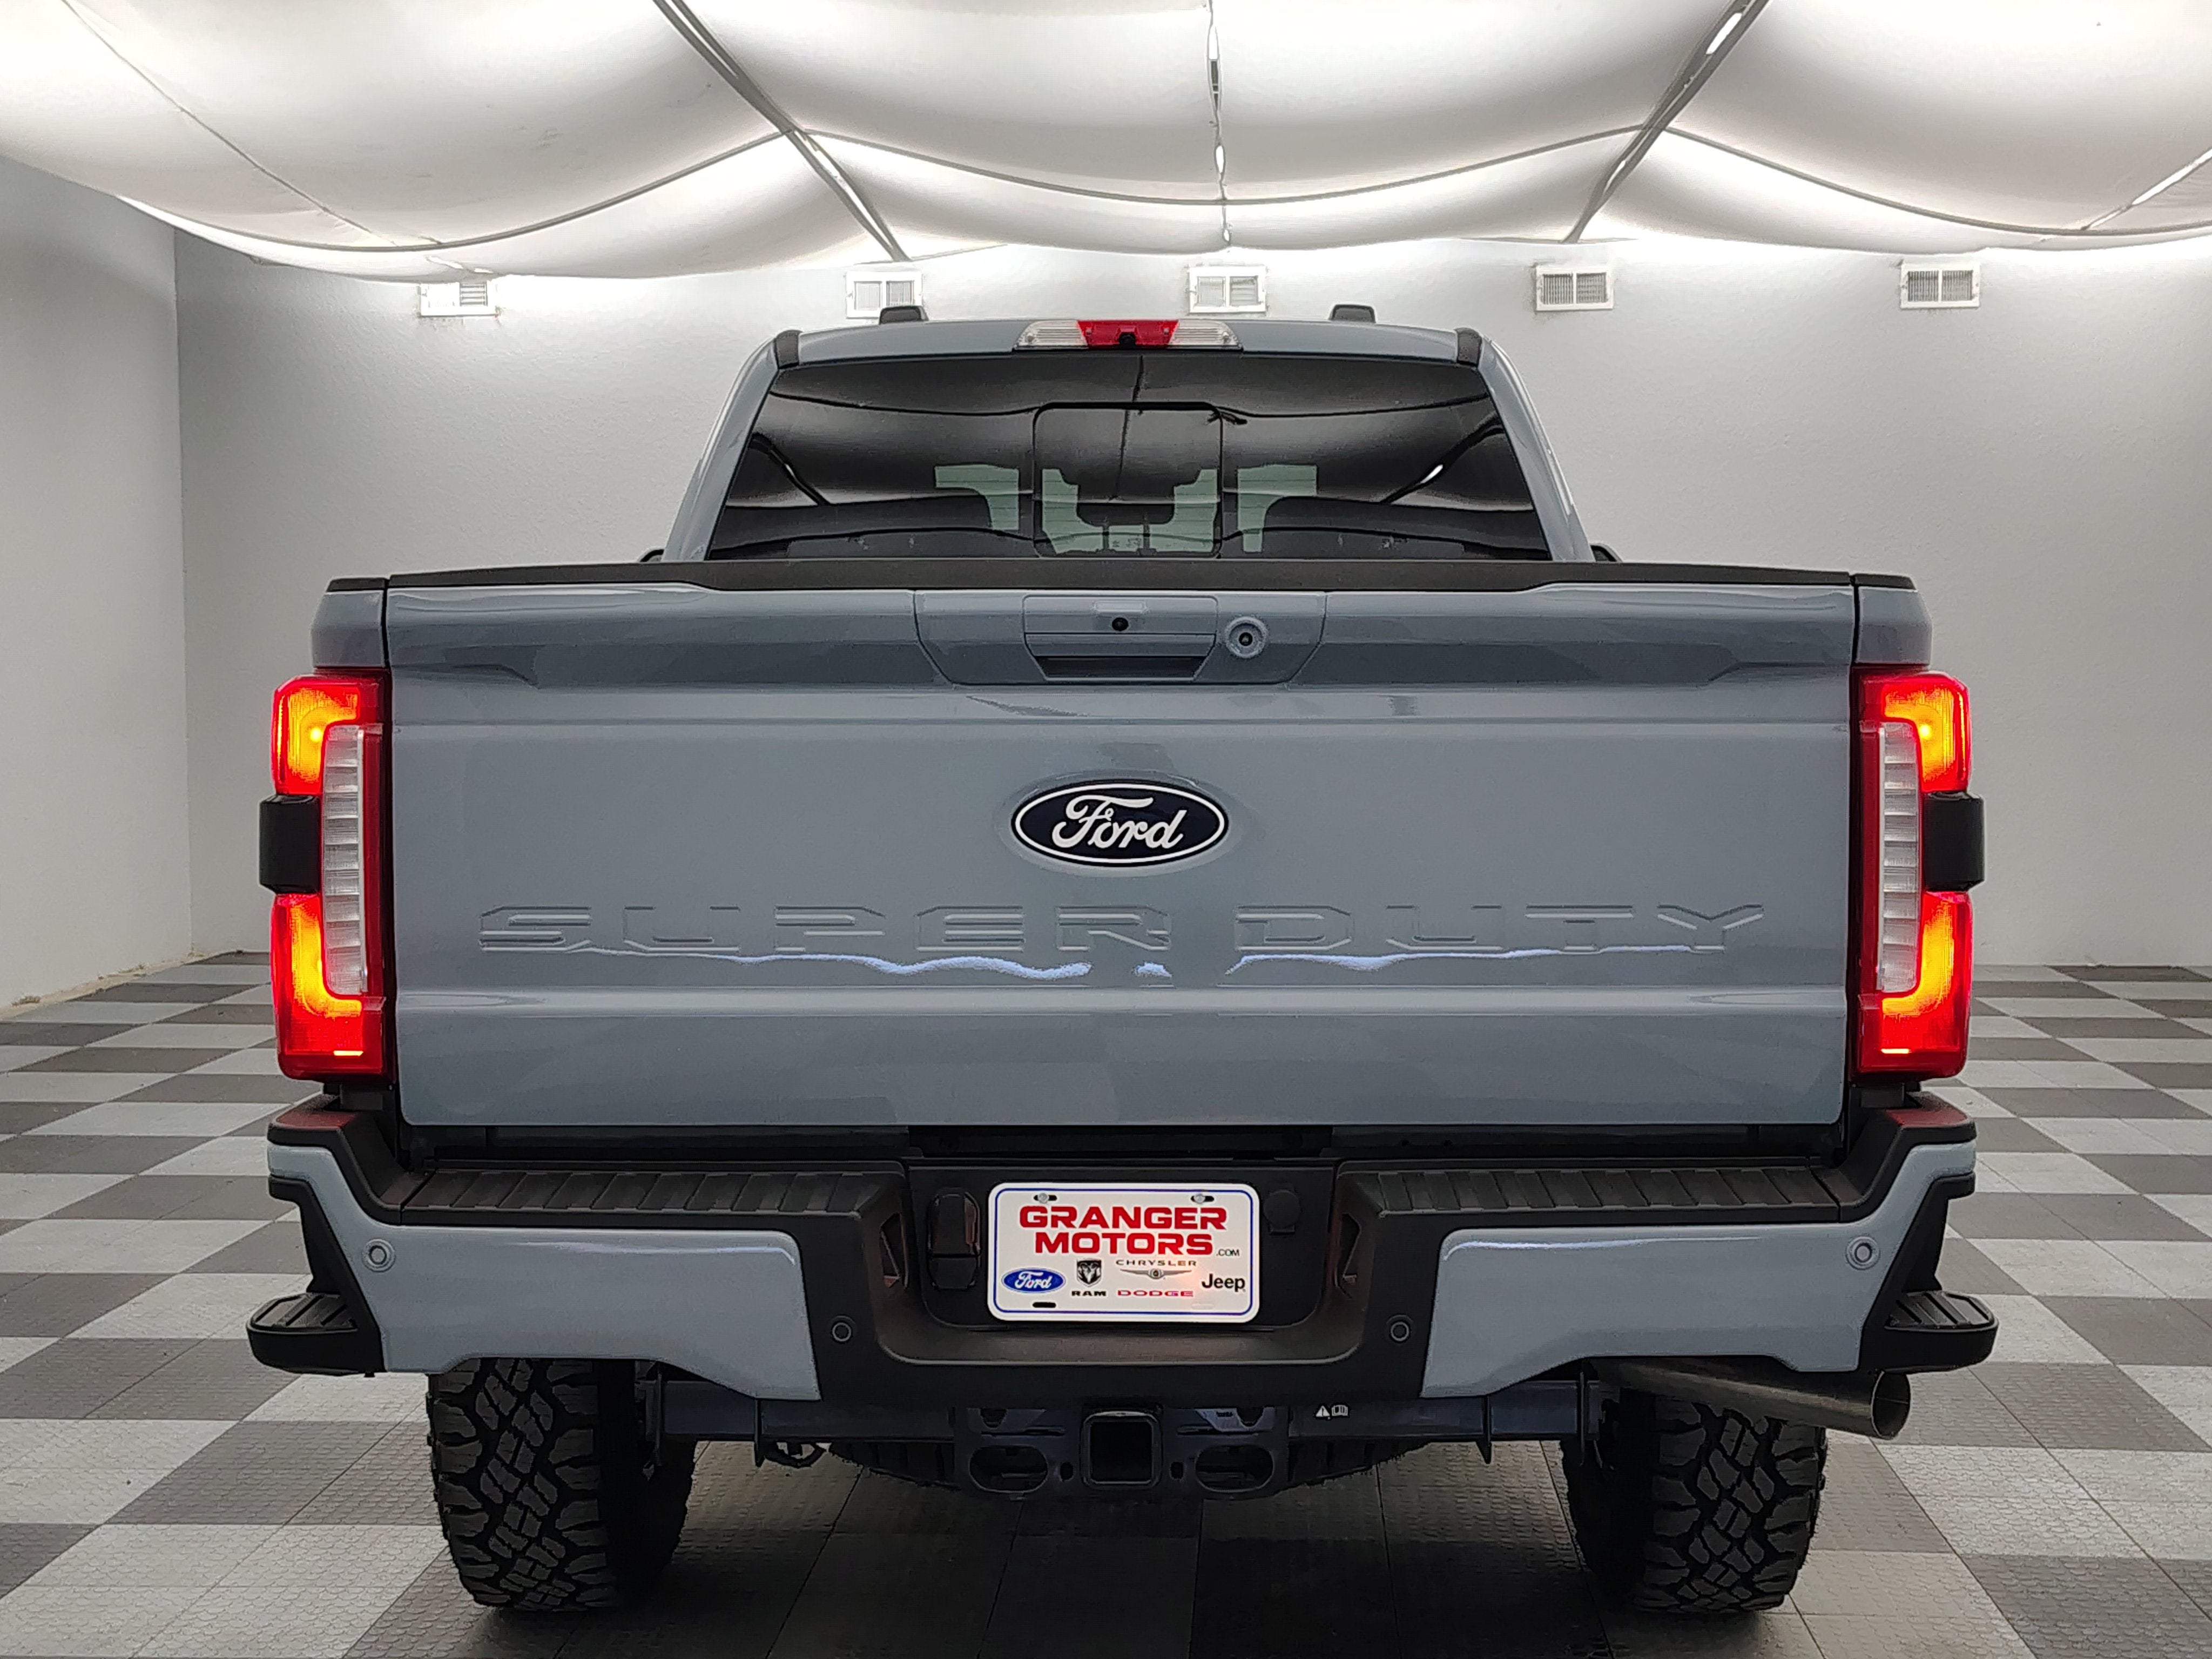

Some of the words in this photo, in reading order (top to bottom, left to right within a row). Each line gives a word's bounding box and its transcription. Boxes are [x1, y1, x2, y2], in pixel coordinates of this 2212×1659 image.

[1051, 794, 1188, 849] Ford
[480, 905, 1172, 953] SUPER
[1233, 904, 1765, 954] DUTY
[1020, 1205, 1228, 1230] GRANGER
[1035, 1232, 1213, 1255] MOTORS
[1216, 1249, 1240, 1257] .COM
[1014, 1271, 1052, 1289] Ford
[1202, 1273, 1245, 1292] Jeep
